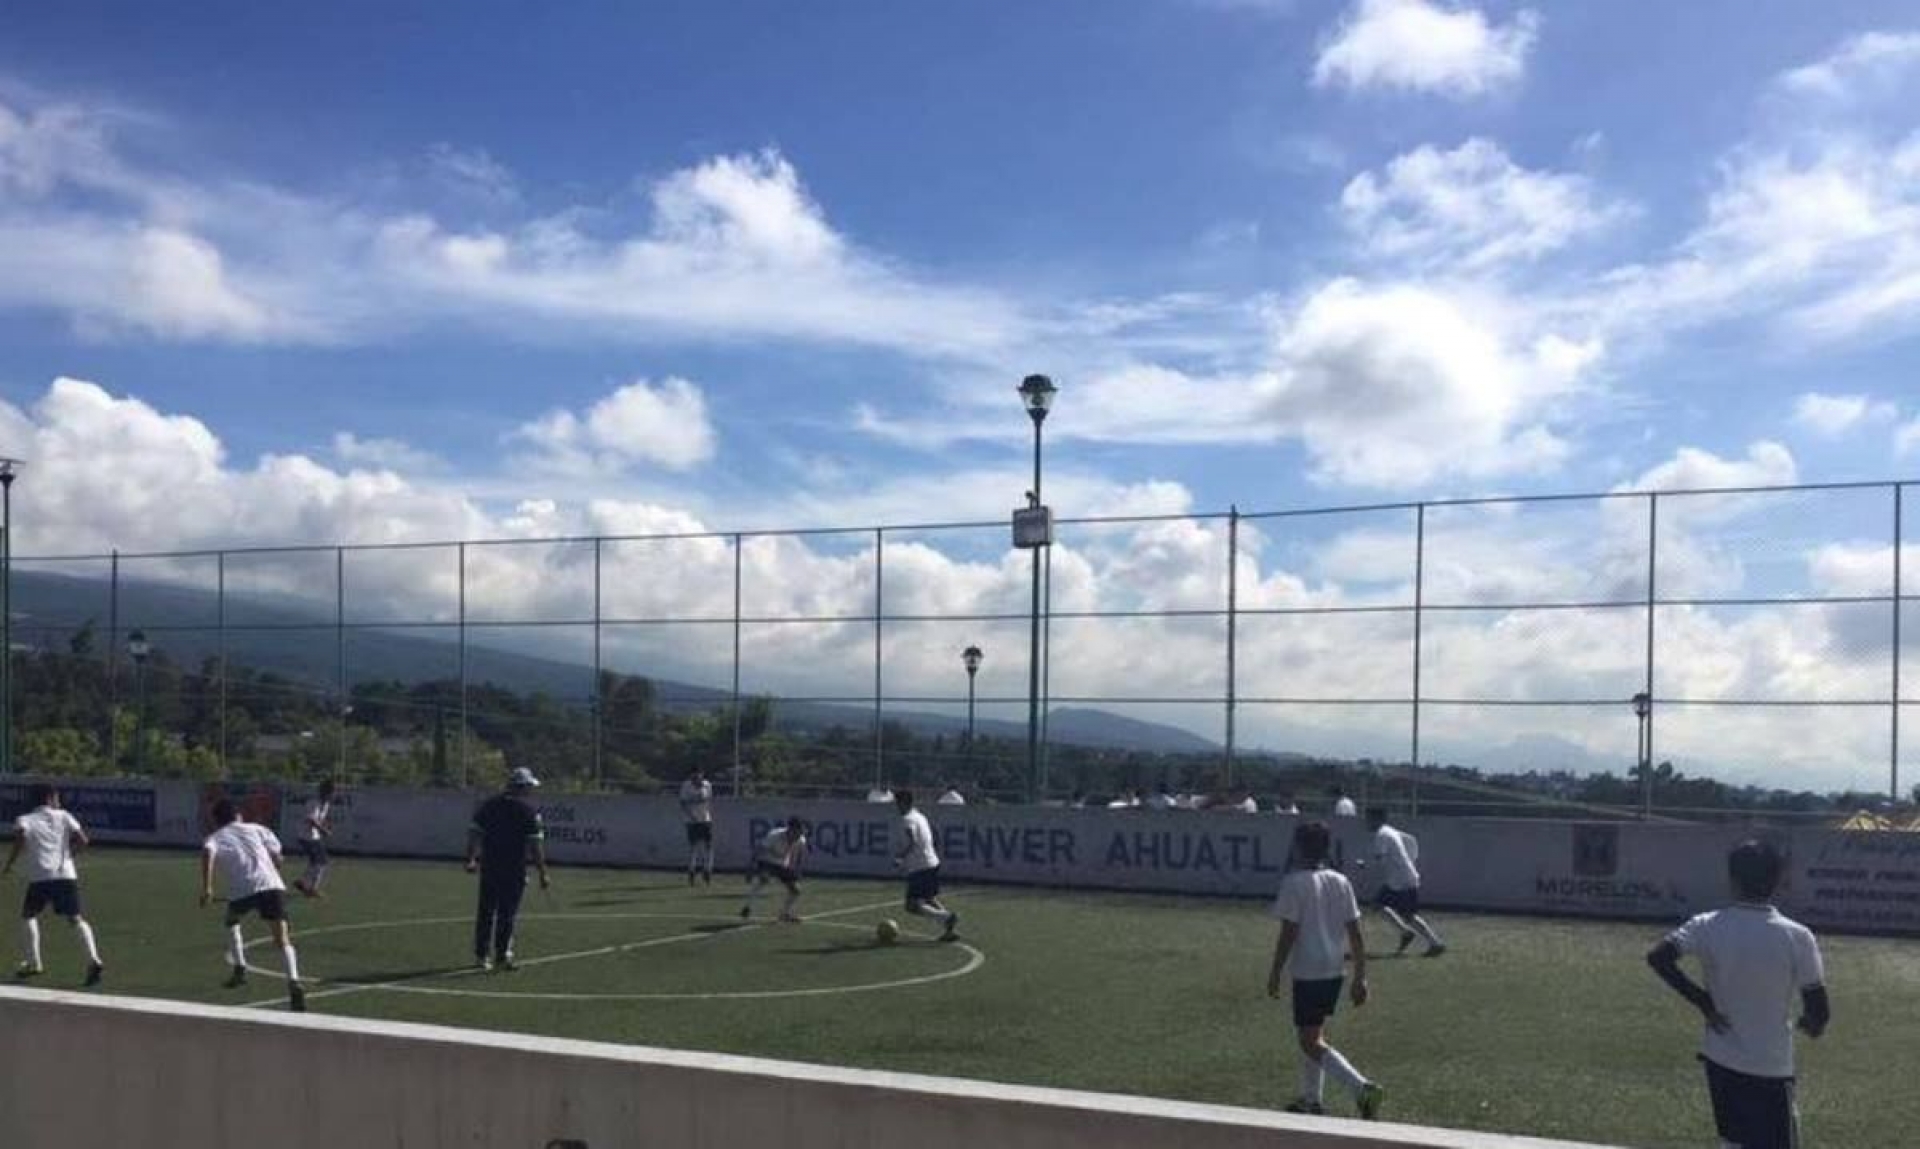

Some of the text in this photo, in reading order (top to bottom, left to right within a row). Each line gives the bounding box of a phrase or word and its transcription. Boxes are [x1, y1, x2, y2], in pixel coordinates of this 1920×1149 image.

[749, 817, 1343, 874] PRQUE ENVER AHUATL
